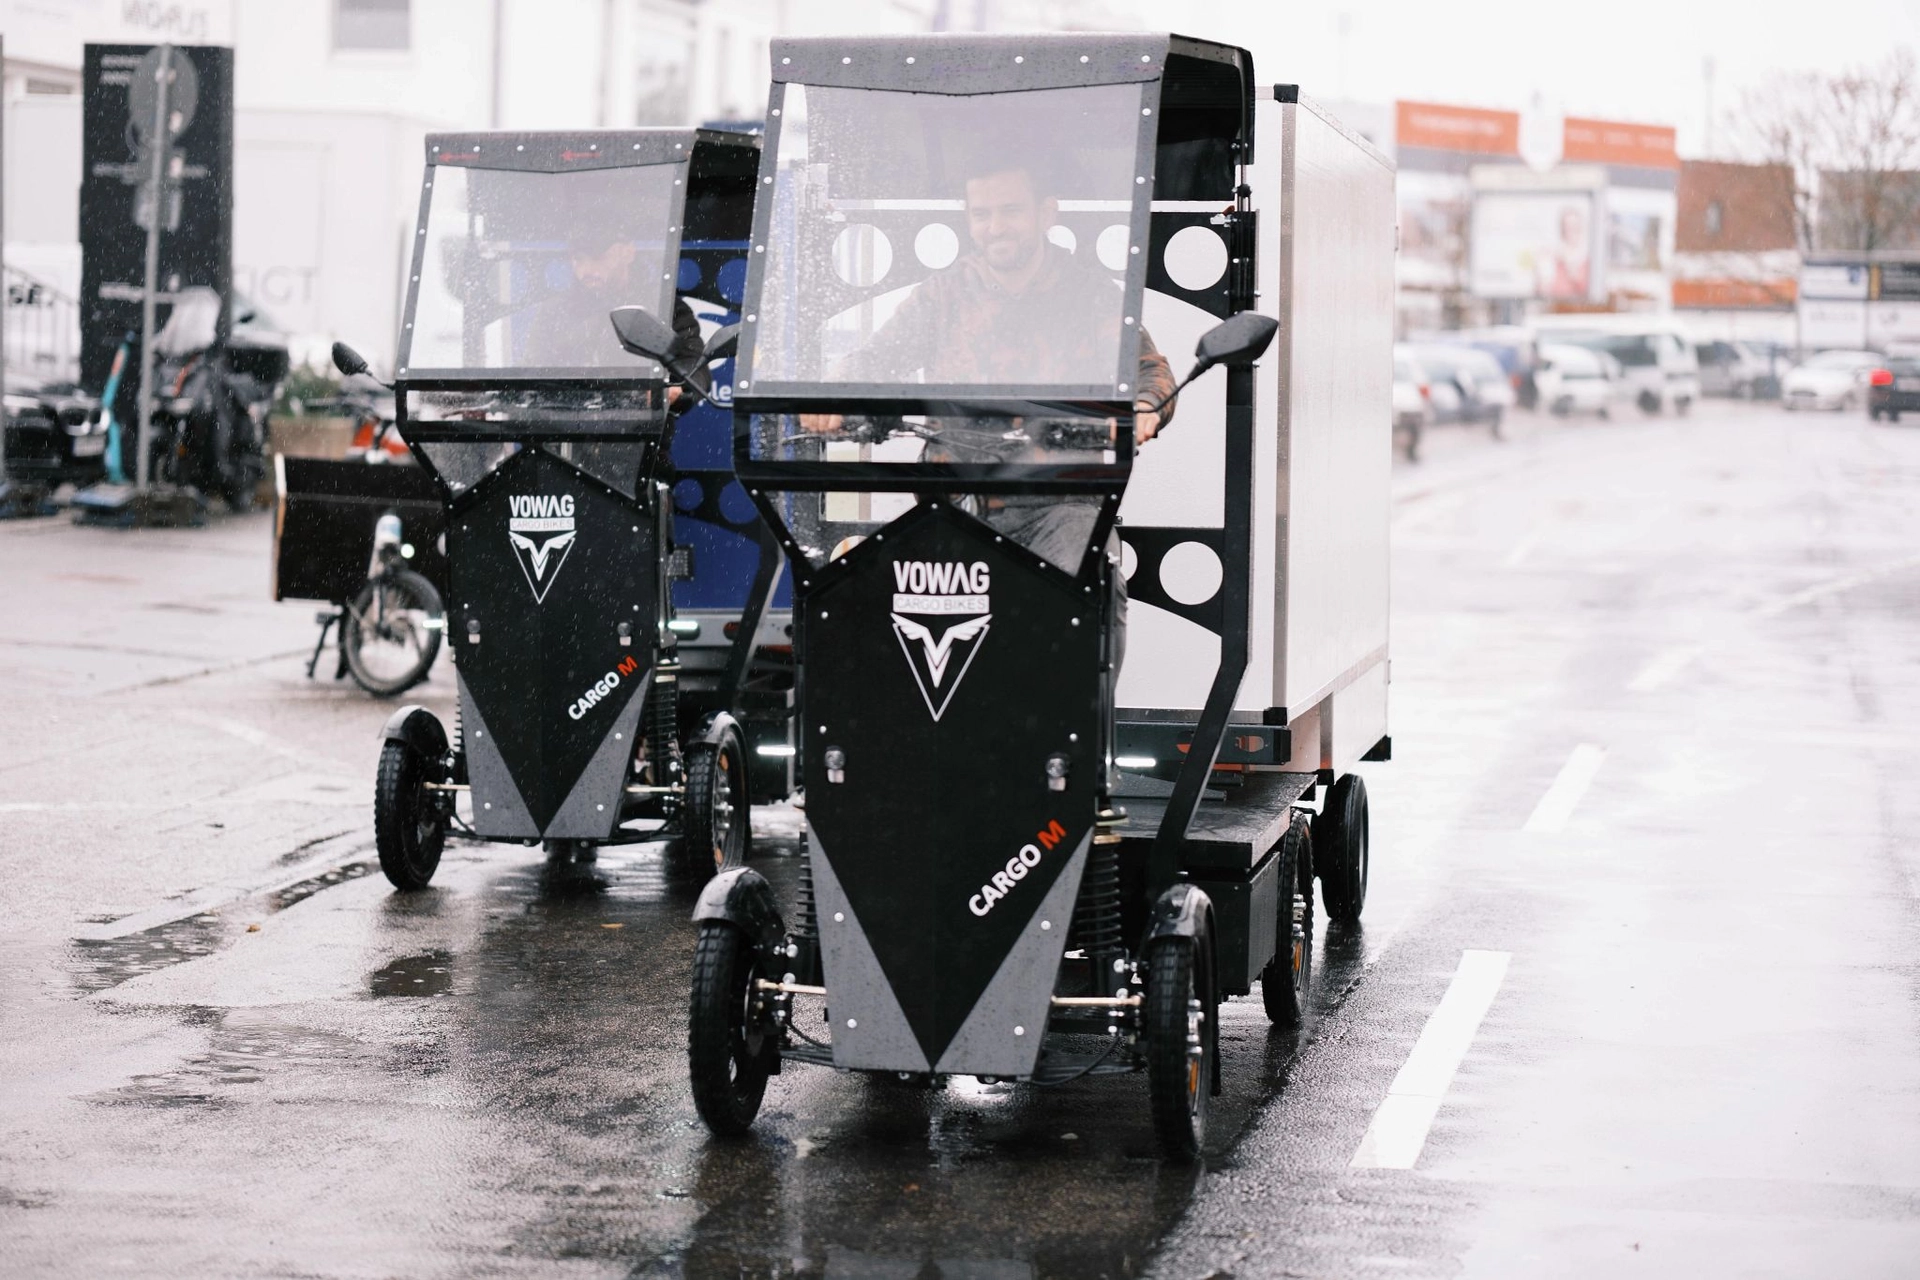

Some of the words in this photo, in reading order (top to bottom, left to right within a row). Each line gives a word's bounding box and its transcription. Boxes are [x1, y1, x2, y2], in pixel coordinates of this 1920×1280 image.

[509, 494, 575, 518] VOWAG
[511, 520, 541, 530] CARGO
[543, 519, 573, 529] BIKES
[893, 560, 990, 594] VOWAG
[895, 598, 940, 611] CARGO
[943, 598, 986, 611] BIKES
[568, 671, 620, 720] CARGO
[617, 655, 638, 677] M
[968, 843, 1042, 917] CARGO
[1037, 819, 1067, 850] M
